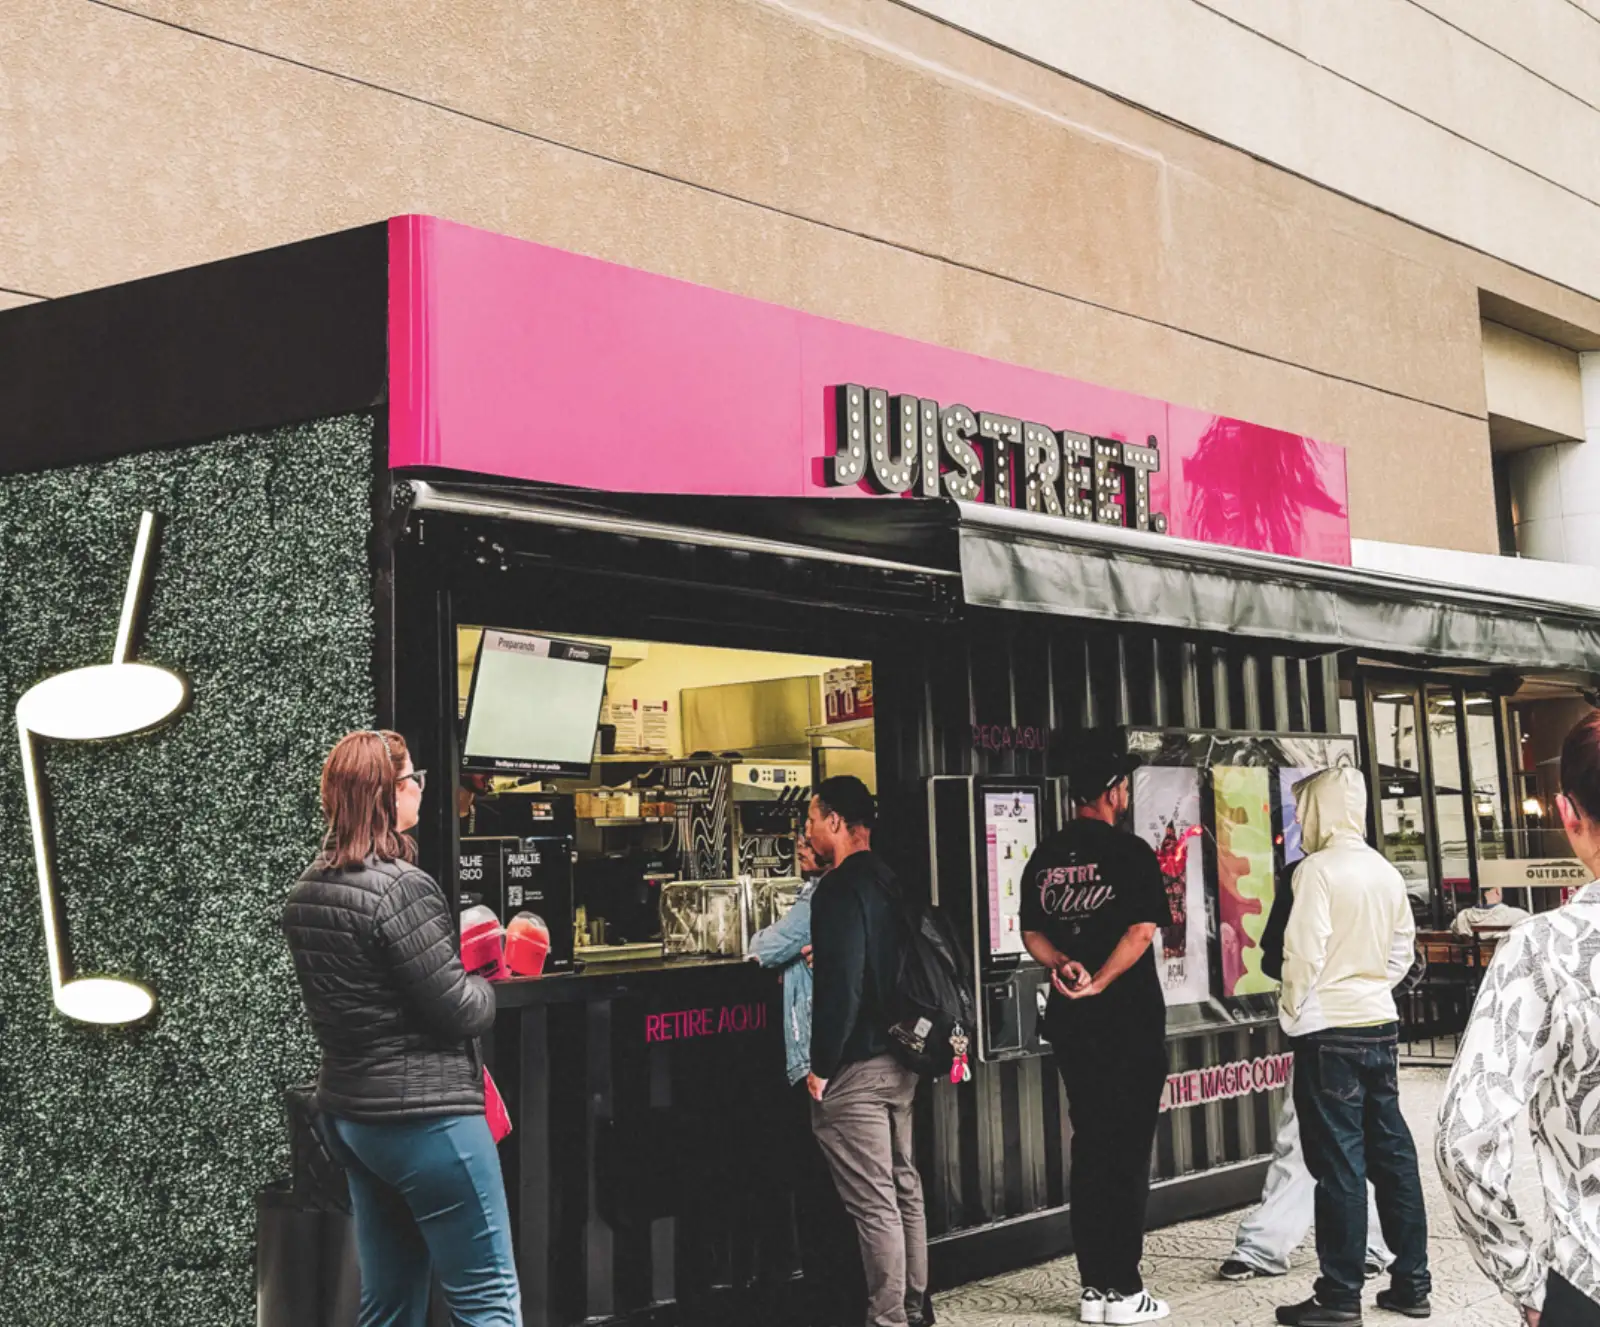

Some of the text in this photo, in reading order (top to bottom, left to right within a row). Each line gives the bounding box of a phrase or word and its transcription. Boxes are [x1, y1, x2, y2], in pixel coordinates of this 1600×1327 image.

[498, 637, 535, 653] Preparando
[508, 853, 541, 865] AVALIE
[1526, 868, 1586, 879] OUTBACK
[1037, 876, 1116, 915] Crew
[646, 1002, 767, 1043] RETIRE AQUI
[1166, 1074, 1199, 1105] THE
[1200, 1063, 1250, 1100] MAGIC
